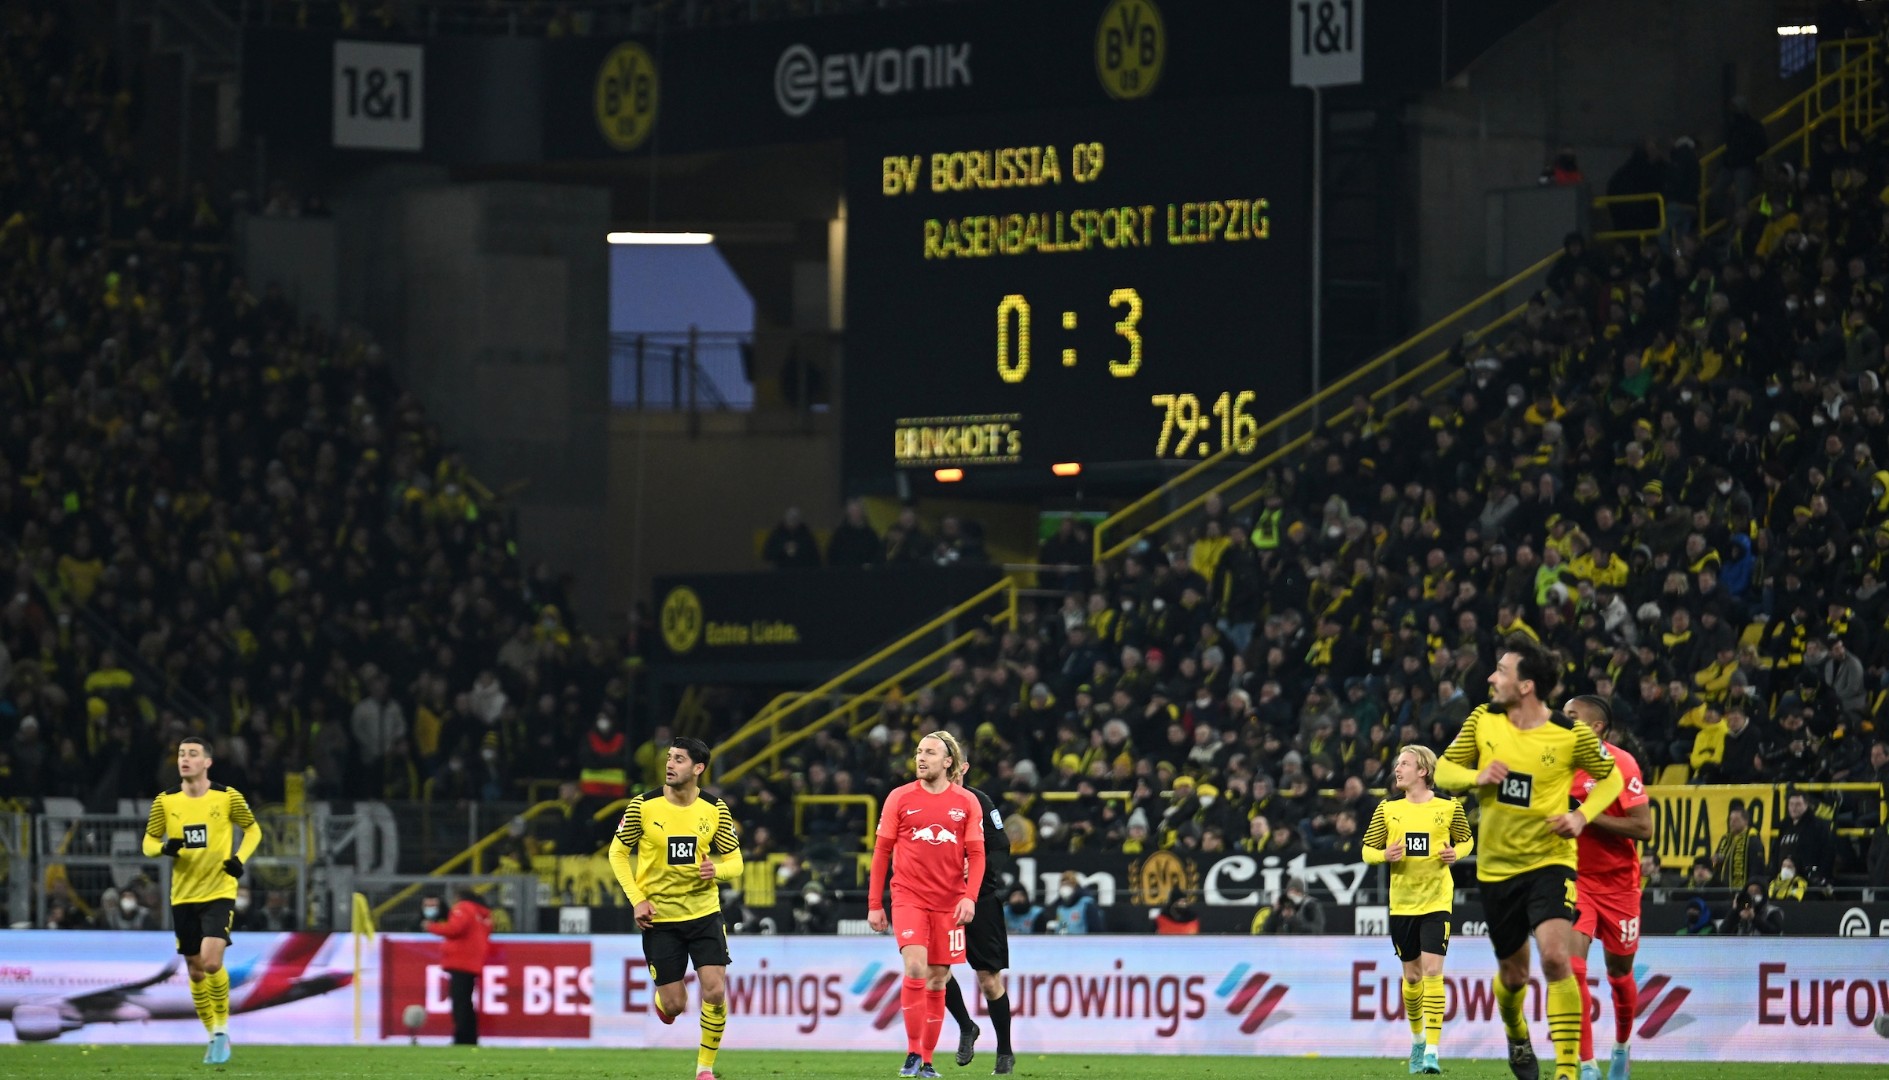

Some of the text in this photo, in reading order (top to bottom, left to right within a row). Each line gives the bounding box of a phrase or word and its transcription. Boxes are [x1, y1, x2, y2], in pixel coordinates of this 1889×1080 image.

[1106, 4, 1155, 70] BVB
[1298, 0, 1353, 56] 1&1
[342, 66, 413, 120] 1&1
[931, 145, 1062, 192] BORUSSIA
[1072, 142, 1105, 183] 09
[923, 198, 1270, 260] RASENBALLSPORT LEIPZIG
[997, 294, 1031, 383] 0
[1109, 288, 1143, 377] 3
[1151, 390, 1258, 458] 79:16
[1502, 778, 1529, 799] 1&1
[185, 828, 206, 843] 1&1
[670, 842, 694, 858] 1&1
[1407, 837, 1427, 851] 1&1
[948, 929, 965, 951] 10
[1618, 916, 1640, 943] 18
[425, 964, 508, 1014] DE
